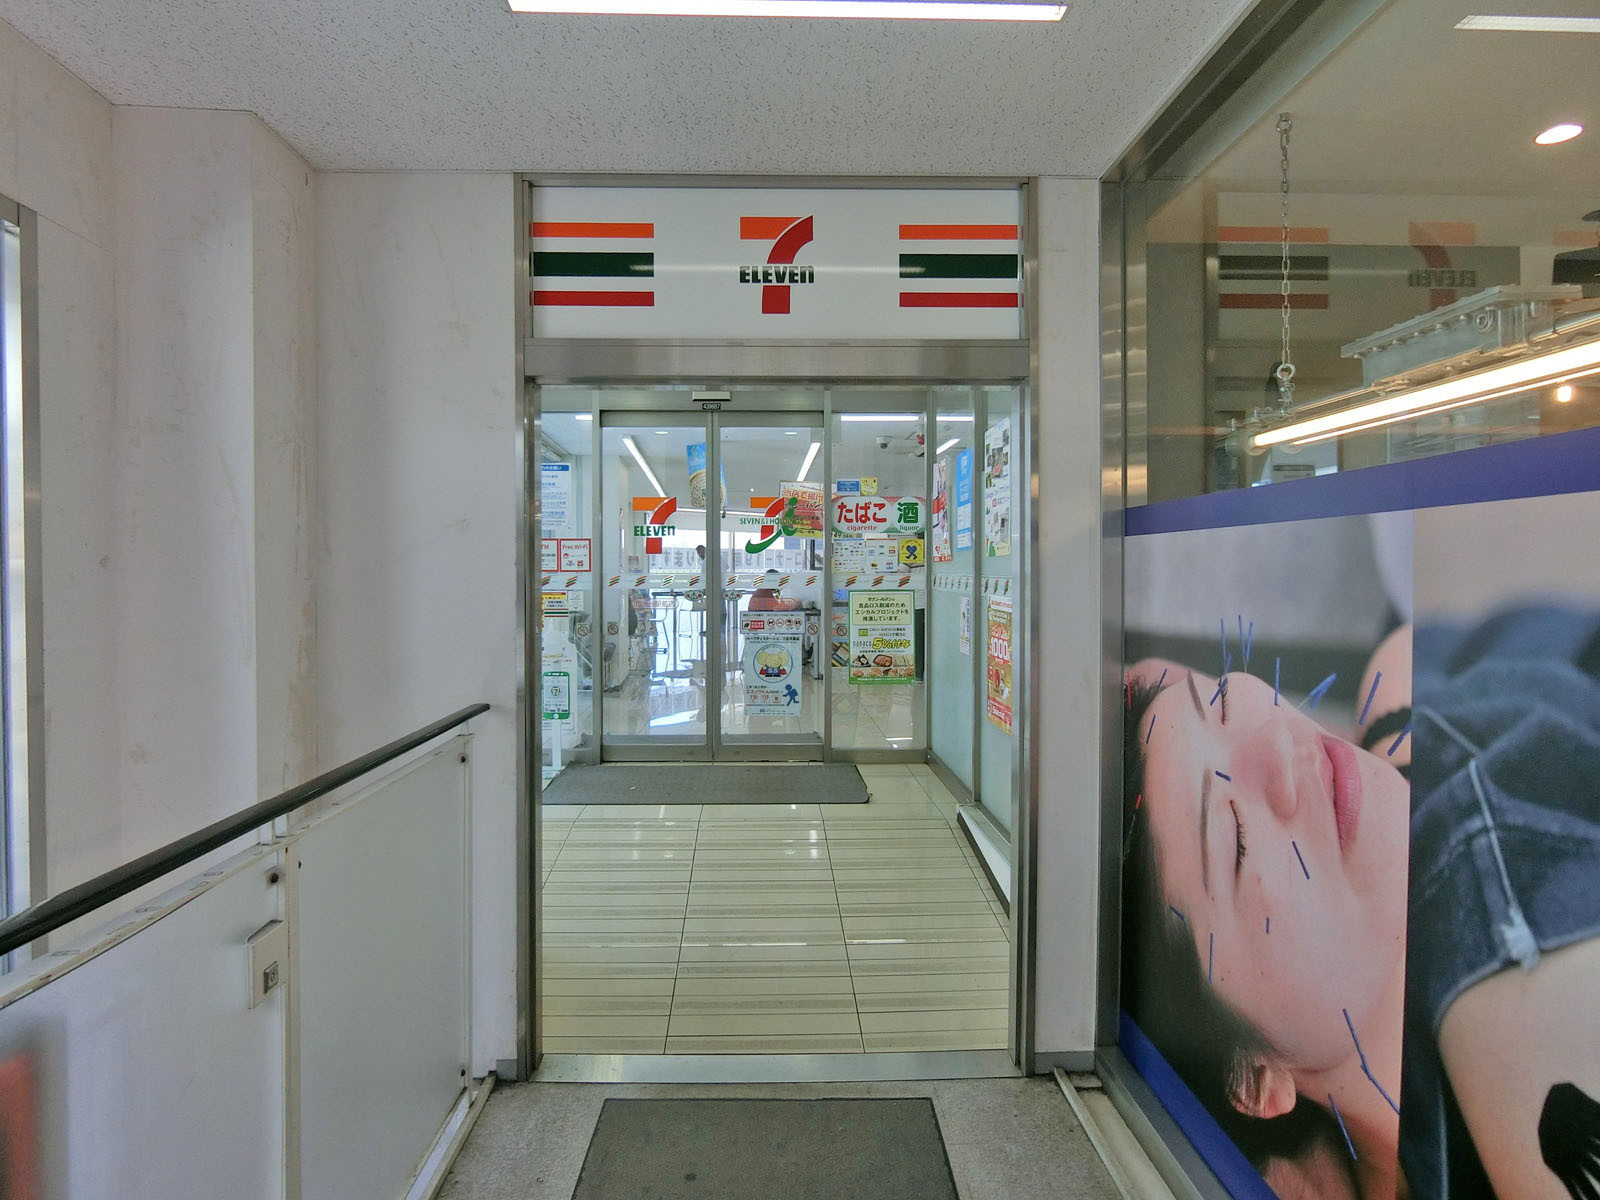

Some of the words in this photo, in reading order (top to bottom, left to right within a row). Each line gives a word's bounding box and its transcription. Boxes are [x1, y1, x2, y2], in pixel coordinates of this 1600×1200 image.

[837, 501, 887, 524] たばこ
[896, 502, 919, 523] 酒
